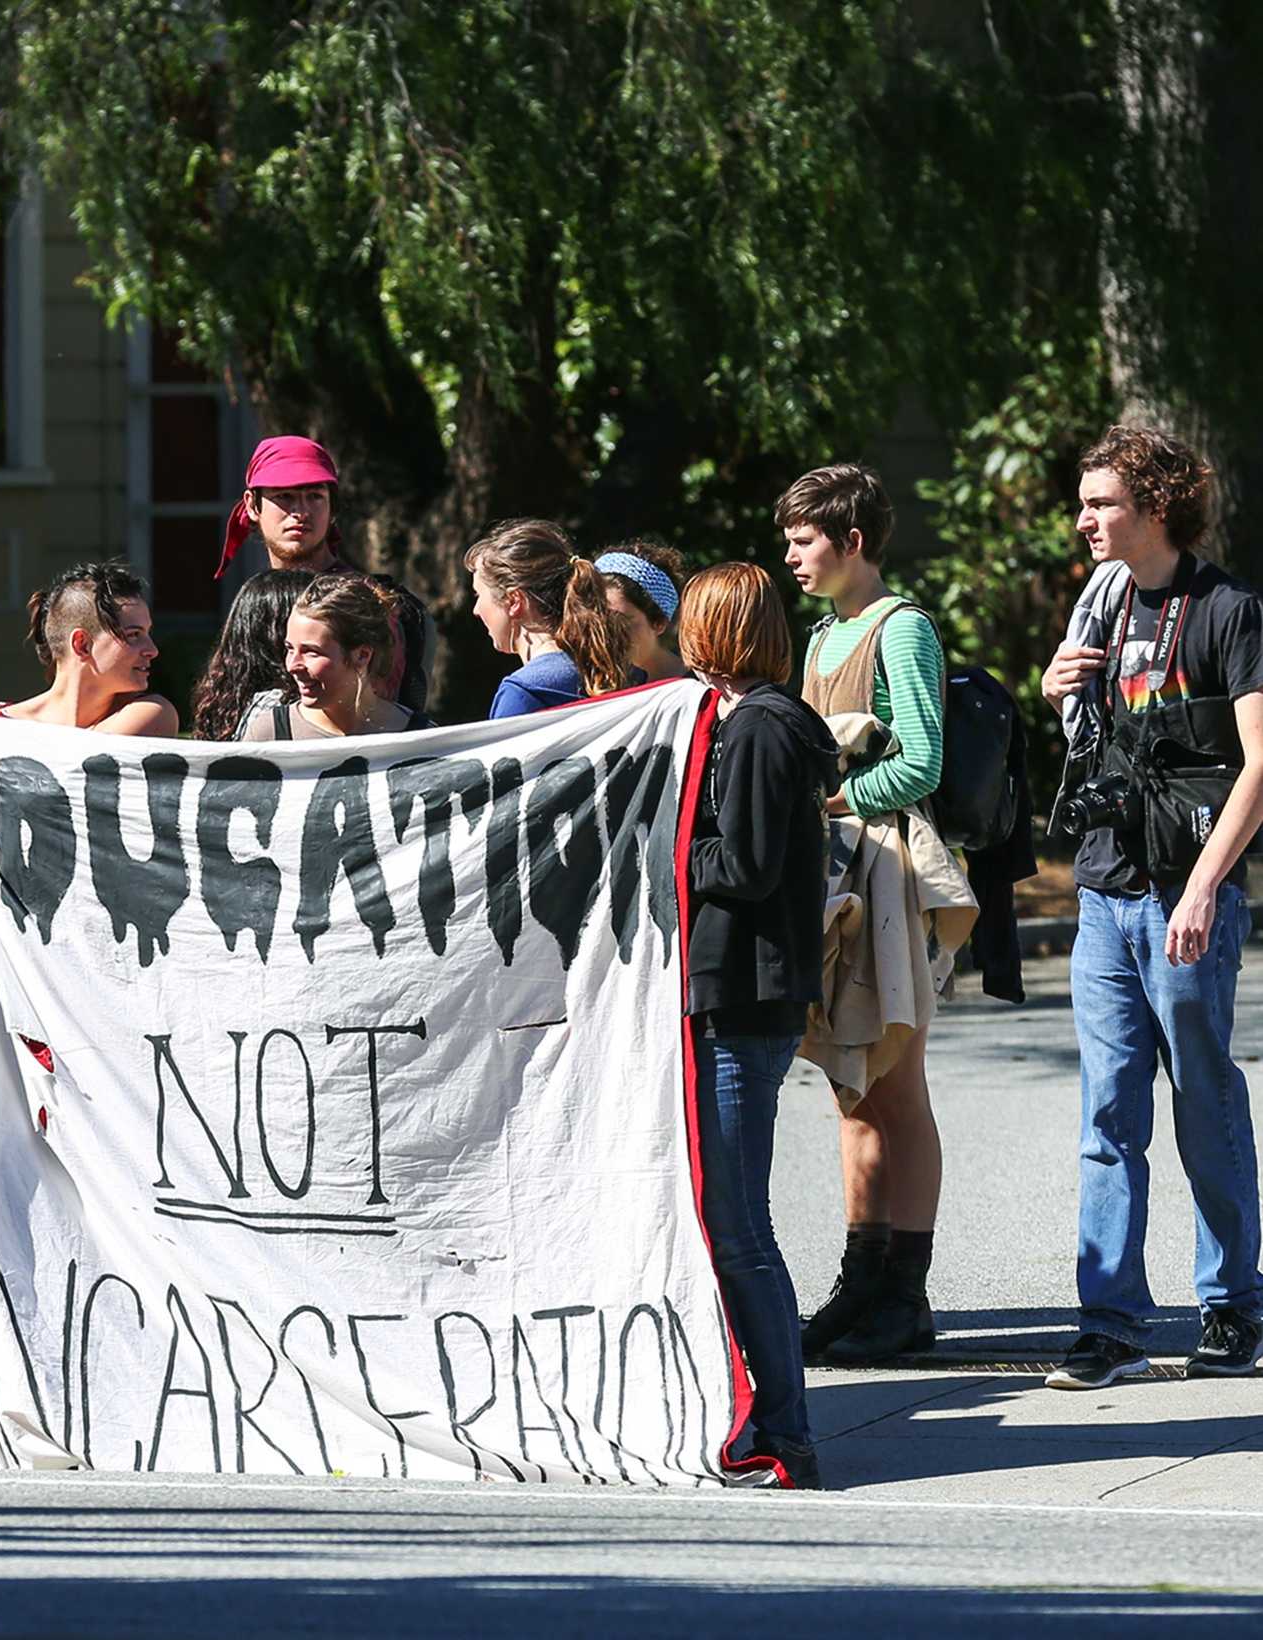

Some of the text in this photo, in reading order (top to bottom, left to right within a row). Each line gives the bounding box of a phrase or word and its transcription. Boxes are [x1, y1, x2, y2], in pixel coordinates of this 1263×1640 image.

[1157, 597, 1181, 661] EOS DIGITAL
[144, 1017, 427, 1206] NOT
